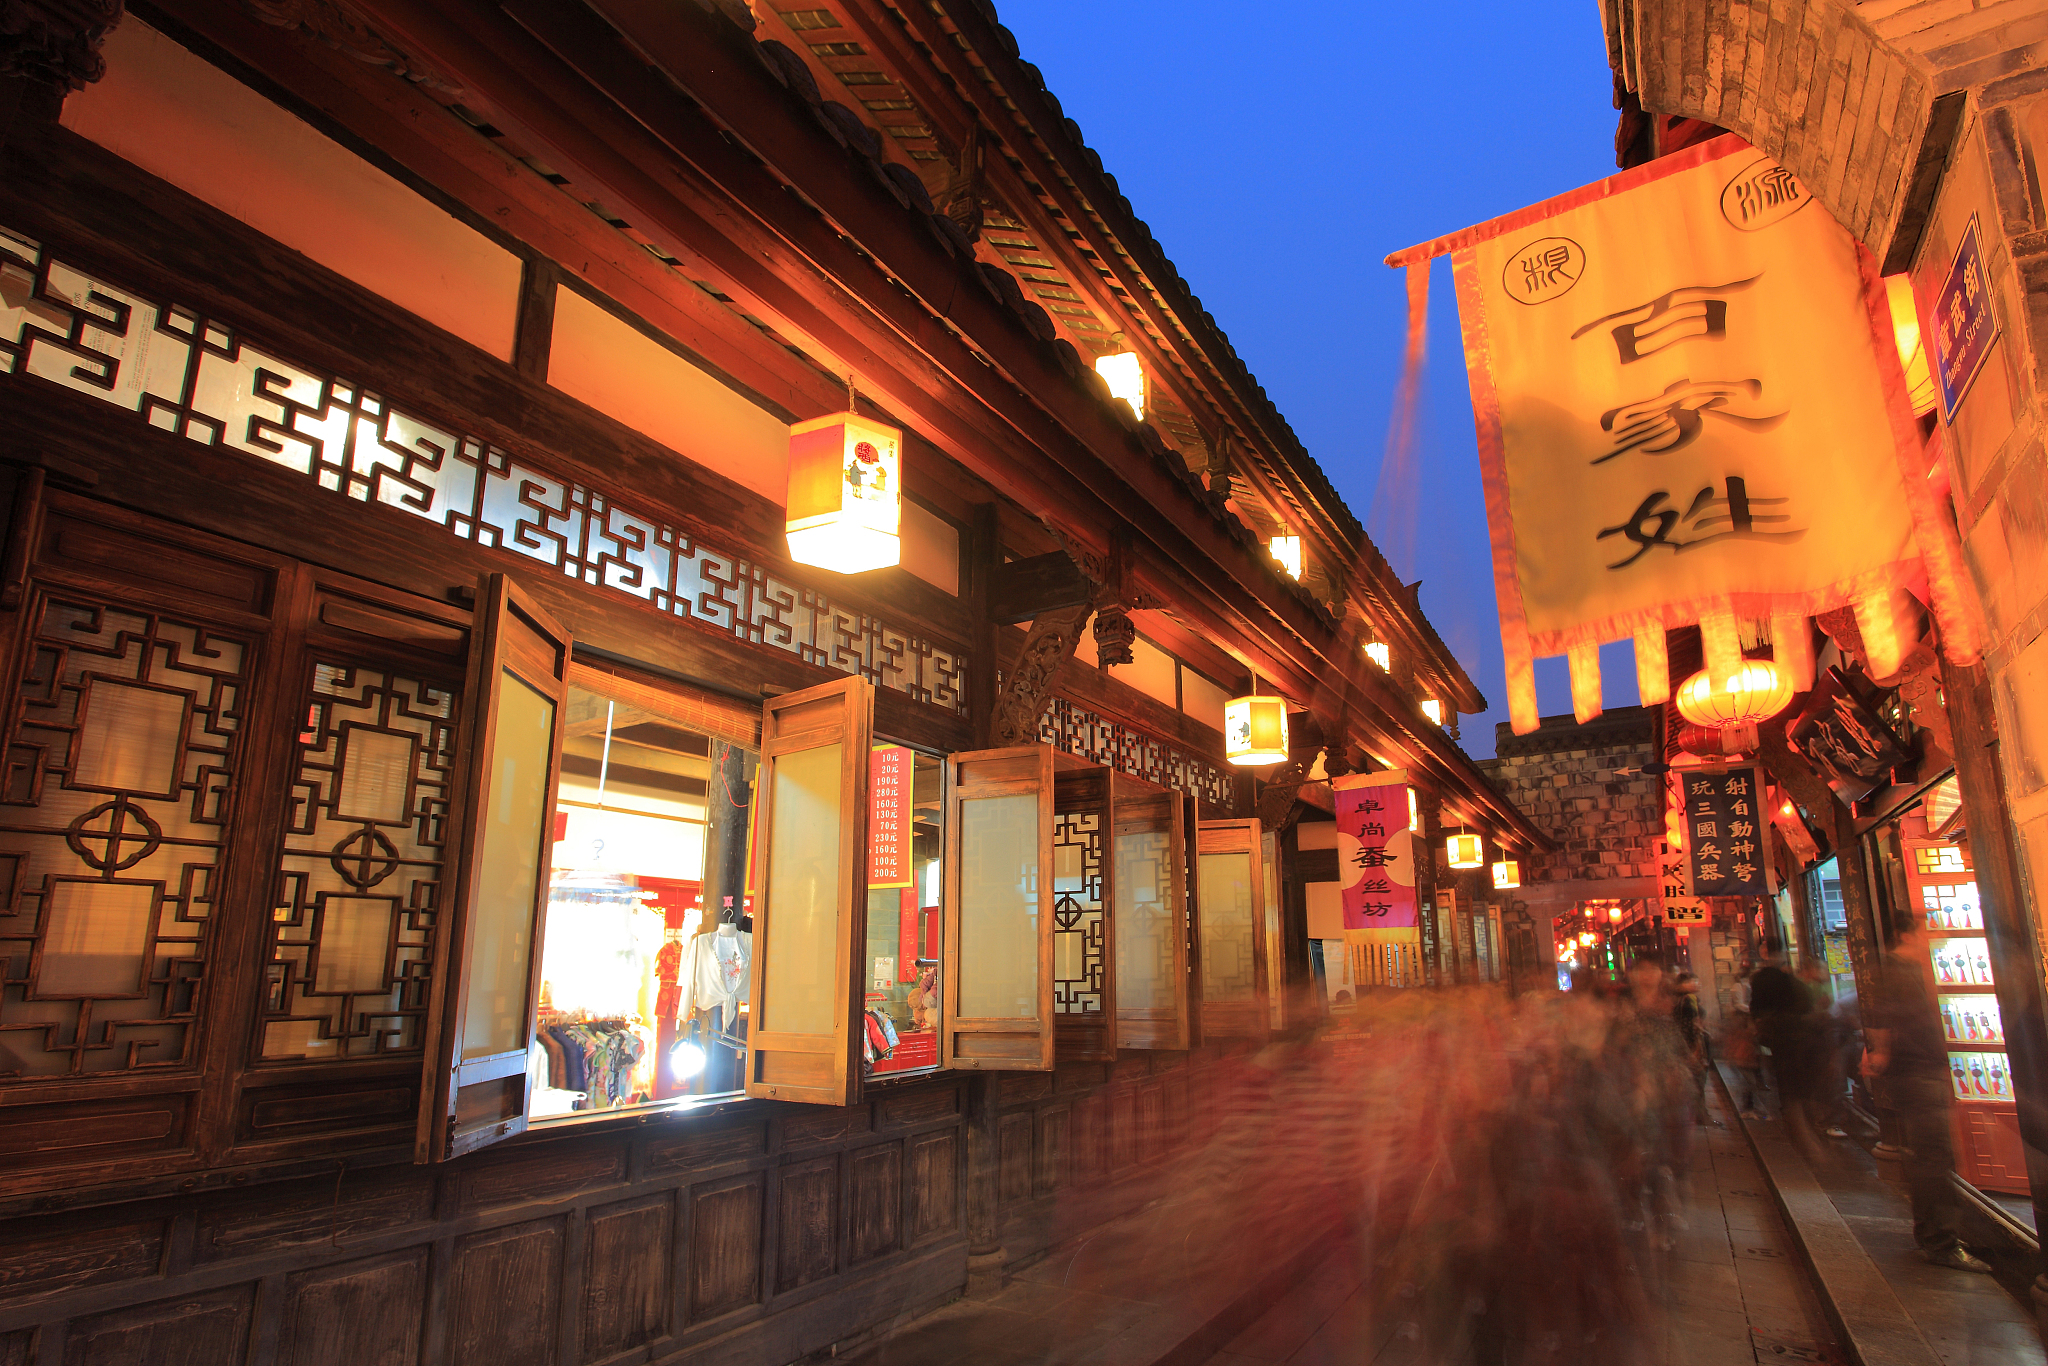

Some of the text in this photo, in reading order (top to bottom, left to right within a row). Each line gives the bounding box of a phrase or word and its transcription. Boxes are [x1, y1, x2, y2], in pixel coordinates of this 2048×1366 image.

[1938, 253, 1980, 364] 章武街
[1944, 301, 1987, 390] Zhangwu Street
[1571, 270, 1810, 571] 百家姓
[882, 751, 899, 763] 10元
[881, 763, 899, 774] 20元
[876, 774, 899, 786] 190元
[876, 786, 899, 797] 280元
[876, 798, 898, 809] 160元
[876, 808, 898, 819] 130元
[880, 820, 898, 831] 70元
[1691, 780, 1725, 882] 玩三國兵器
[1725, 777, 1757, 883] 射自動神弩
[875, 832, 898, 842] 230元
[875, 843, 897, 854] 160元
[874, 855, 898, 866] 100元
[1351, 799, 1398, 917] 卓尚蚕丝坊
[874, 867, 897, 878] 200元
